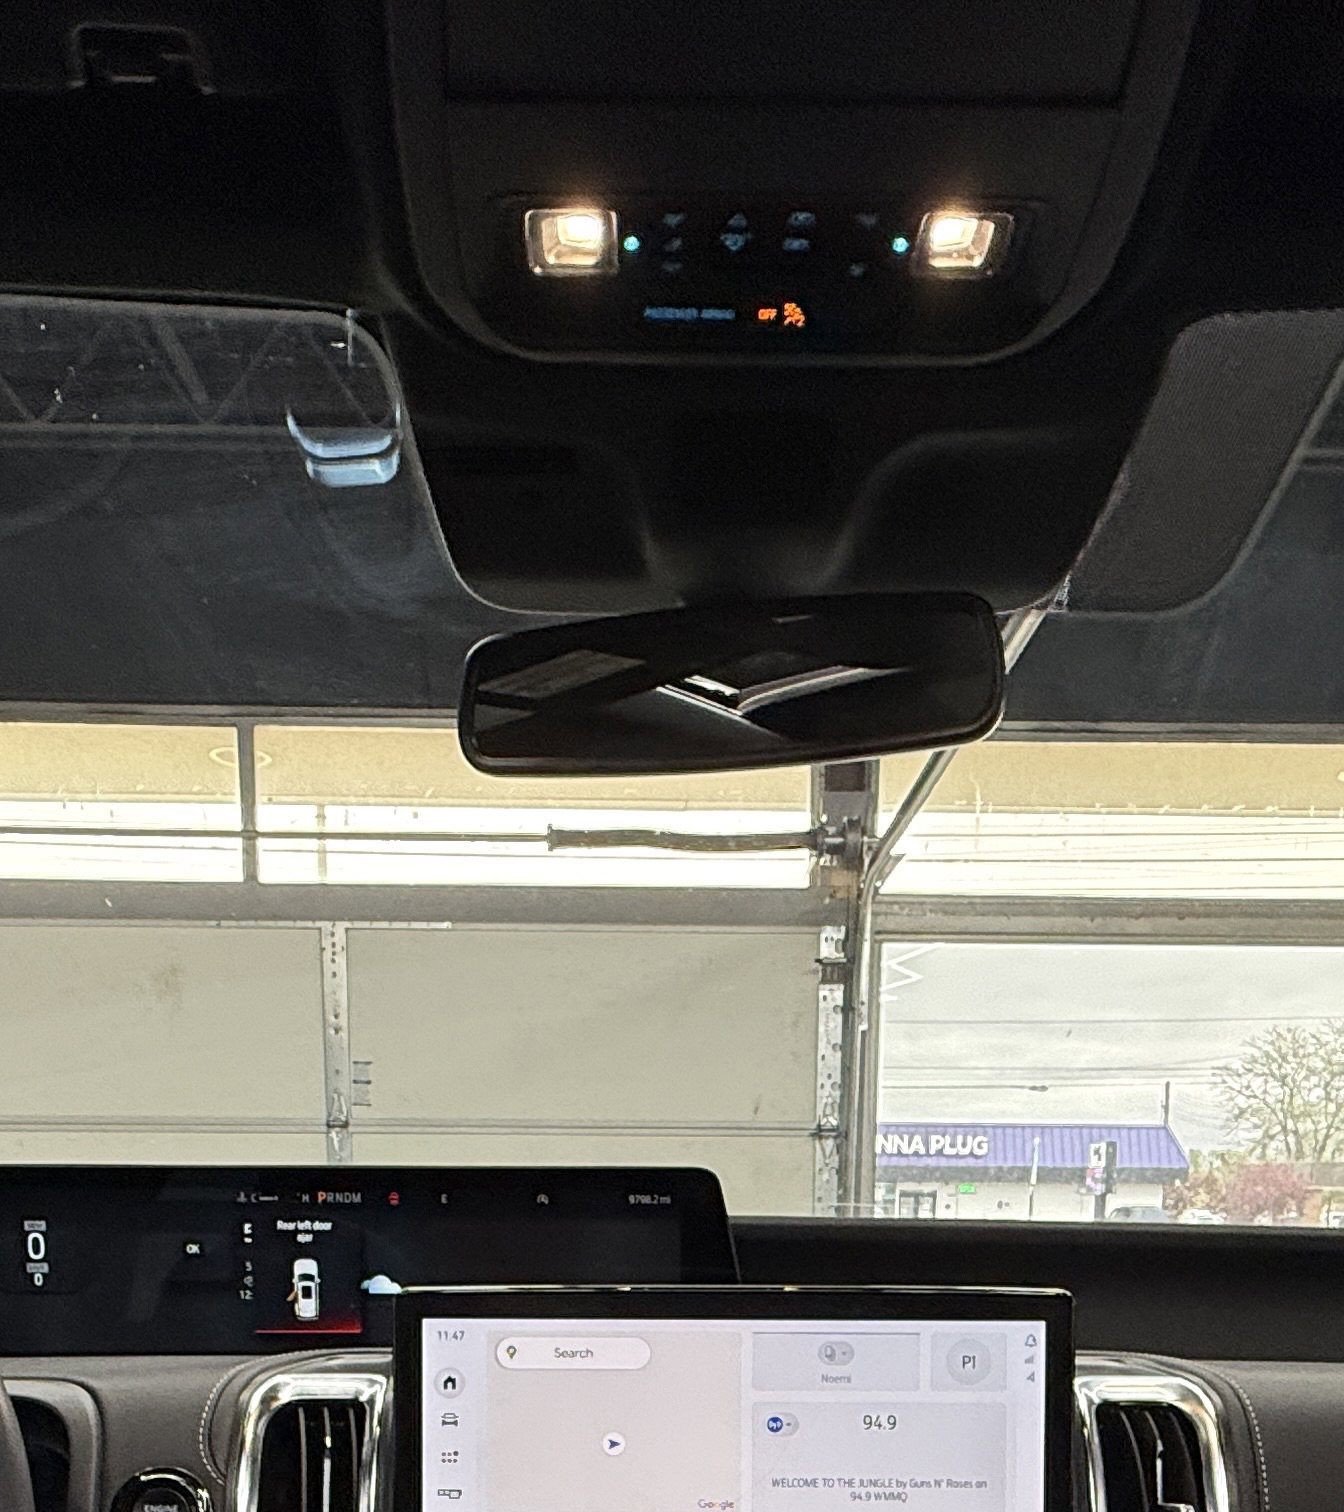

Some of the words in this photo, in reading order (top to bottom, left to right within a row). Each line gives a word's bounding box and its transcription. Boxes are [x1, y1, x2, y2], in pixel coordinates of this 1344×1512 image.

[929, 1134, 989, 1156] PLUG
[276, 1220, 296, 1231] Rear
[297, 1220, 313, 1231] left
[313, 1220, 333, 1231] door
[27, 1232, 45, 1260] 0
[186, 1244, 200, 1254] OK
[34, 1272, 43, 1286] 0
[554, 1347, 594, 1359] Search
[961, 1355, 977, 1369] P1
[821, 1373, 852, 1384] Noemi
[862, 1414, 897, 1431] 94.9
[771, 1478, 819, 1489] WELCOME
[823, 1478, 835, 1489] TO
[837, 1478, 856, 1489] THE
[858, 1478, 894, 1489] JUNGLE
[895, 1478, 908, 1490] by
[909, 1478, 932, 1489] Guns
[946, 1478, 973, 1489] Roses
[975, 1480, 988, 1489] on
[850, 1491, 872, 1501] 94.9
[697, 1498, 735, 1510] Google
